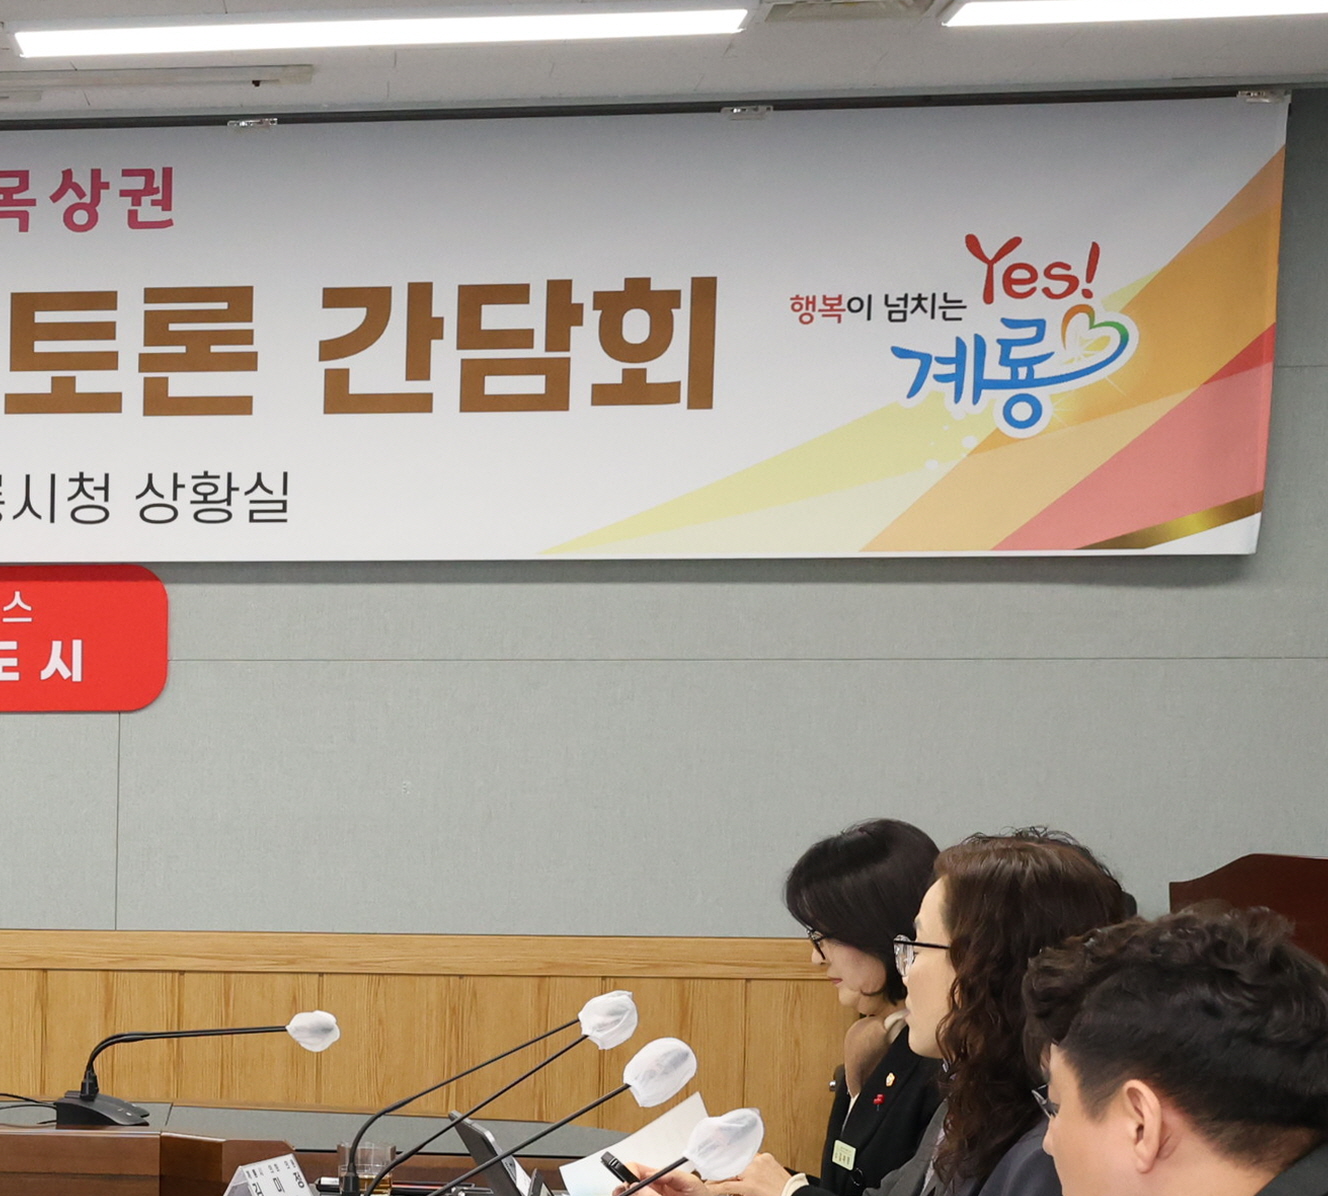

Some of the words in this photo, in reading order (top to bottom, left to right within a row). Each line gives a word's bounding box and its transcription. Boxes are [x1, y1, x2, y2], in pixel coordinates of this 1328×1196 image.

[963, 232, 1101, 306] Yes!
[789, 293, 873, 325] 행복이
[883, 291, 968, 323] 넘치는
[4, 285, 259, 417] 토론
[318, 275, 718, 415] 간담회
[890, 317, 1056, 430] 계룡
[135, 470, 289, 525] 상황실
